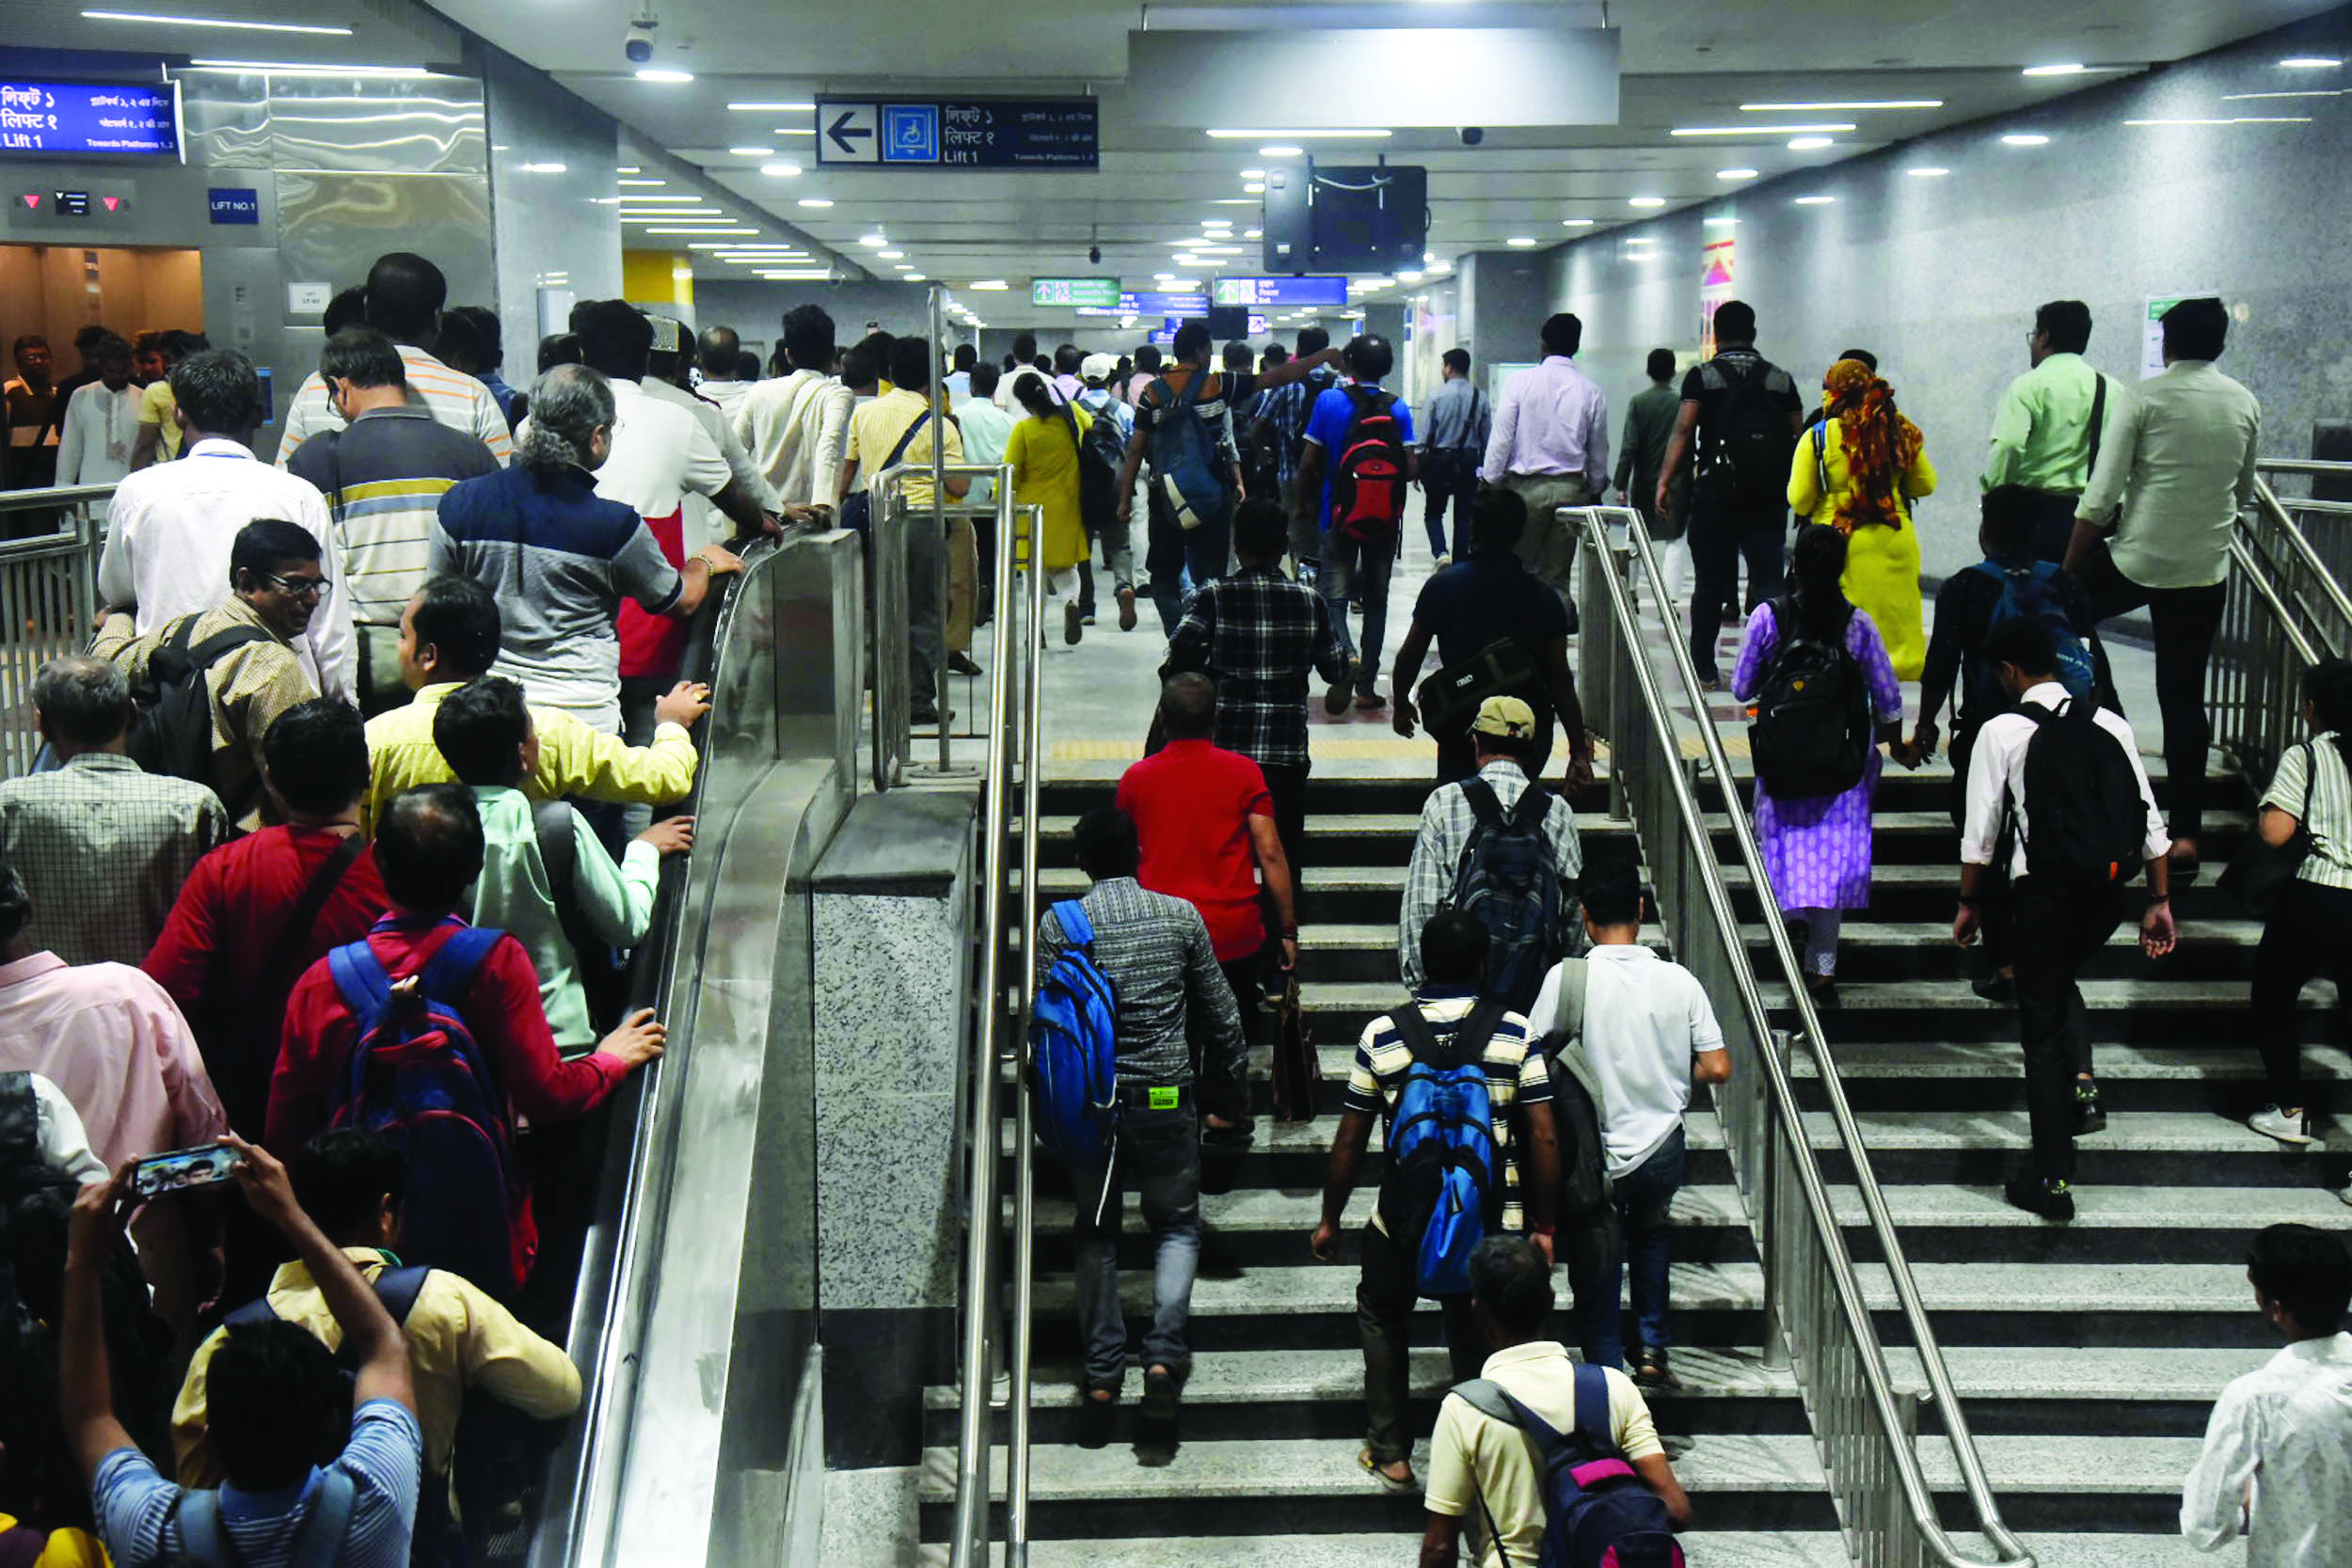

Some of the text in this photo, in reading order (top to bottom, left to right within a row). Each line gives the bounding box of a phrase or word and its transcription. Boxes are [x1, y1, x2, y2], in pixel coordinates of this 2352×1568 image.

[45, 92, 56, 108] ১
[0, 107, 57, 130] लिफ्ट १
[985, 110, 993, 124] ১
[3, 133, 42, 148] Lift 1
[945, 126, 994, 146] लिफ्ट १
[945, 150, 977, 163] Lift 1
[212, 201, 231, 210] LIFT
